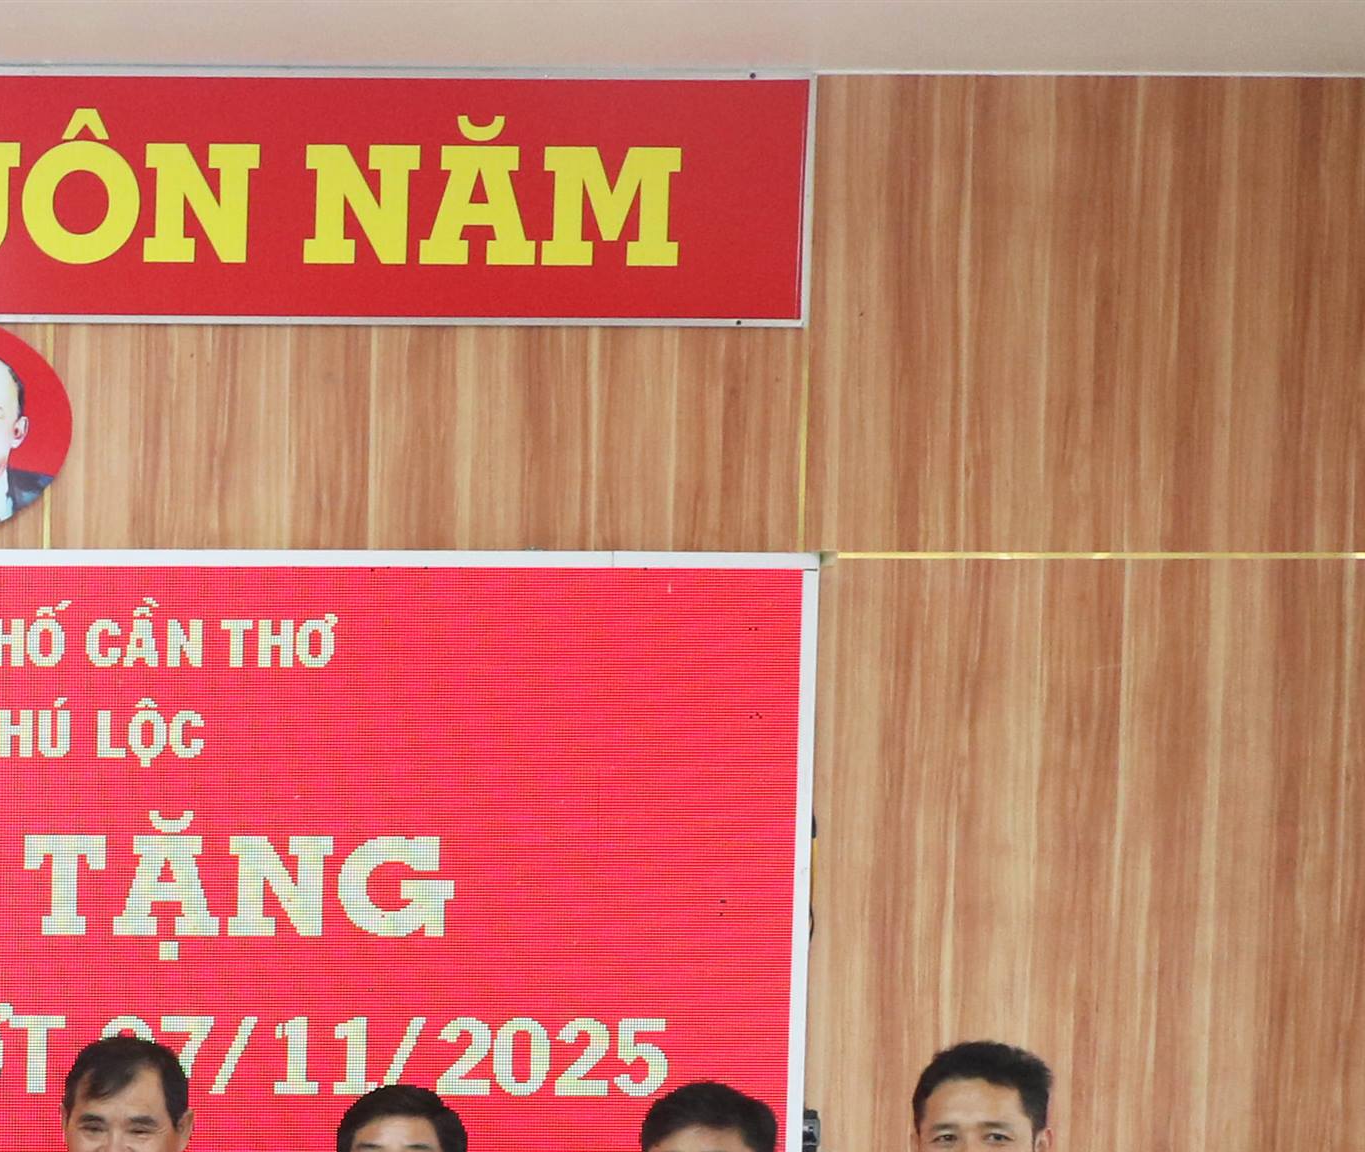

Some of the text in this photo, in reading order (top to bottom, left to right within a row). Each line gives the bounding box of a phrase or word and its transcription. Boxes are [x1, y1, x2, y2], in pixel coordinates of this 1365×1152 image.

[303, 115, 682, 268] NĂM
[86, 597, 204, 669] CẦN
[220, 613, 340, 669] THƠ
[97, 698, 206, 769] LỘC
[24, 810, 456, 964] TẶNG
[99, 1015, 669, 1097] 7/11/2025
